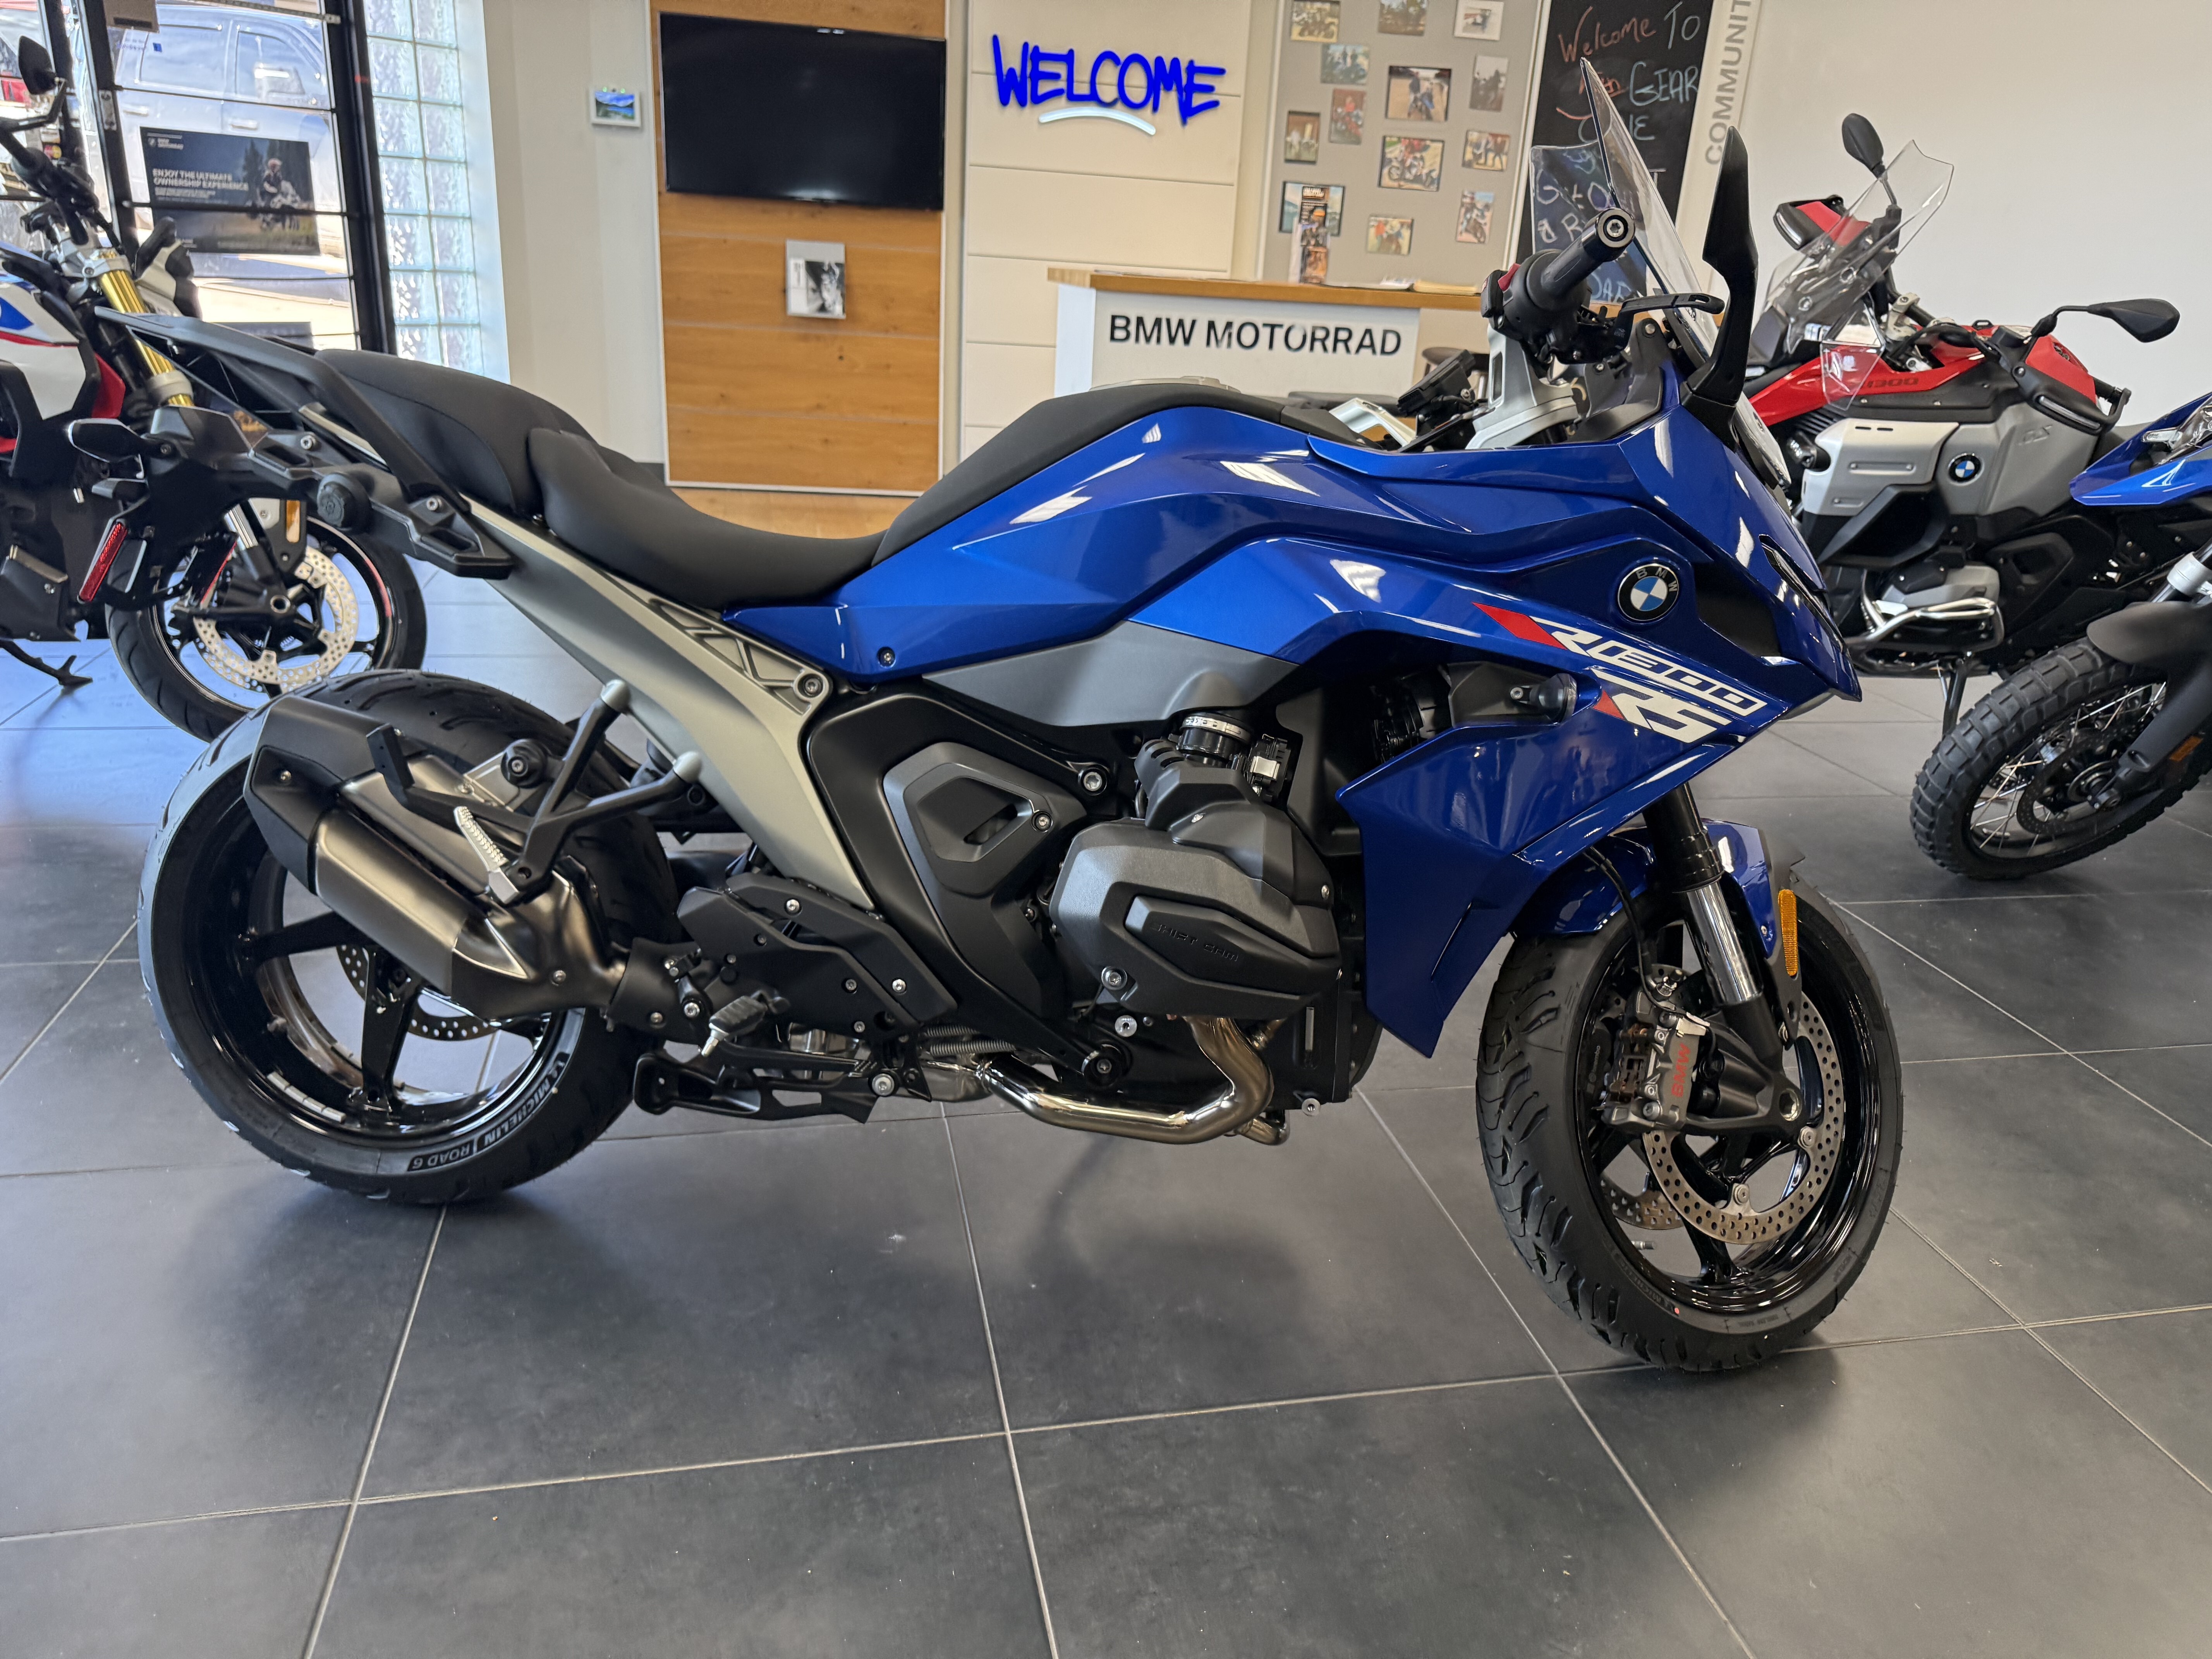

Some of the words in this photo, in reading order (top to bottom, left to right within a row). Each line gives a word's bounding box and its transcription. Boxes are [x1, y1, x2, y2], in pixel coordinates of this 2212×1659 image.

[1558, 6, 1657, 62] Welcome
[992, 34, 1226, 126] WELCOME
[1630, 61, 1698, 106] GEAR
[153, 168, 178, 178] ENJOY
[179, 170, 194, 179] THE
[195, 171, 232, 182] ULTIMATE
[153, 177, 201, 188] OWNERSHIP
[202, 180, 249, 191] EXPERIENCE
[1109, 314, 1197, 347] BMW
[1206, 319, 1401, 356] MOTORRAD
[1635, 567, 1678, 592] BMW
[1589, 665, 1732, 743] RS
[1671, 1042, 1692, 1097] BMW
[483, 1079, 551, 1147] MICHELIN
[413, 1156, 423, 1169] 6
[428, 1143, 471, 1166] ROAD
